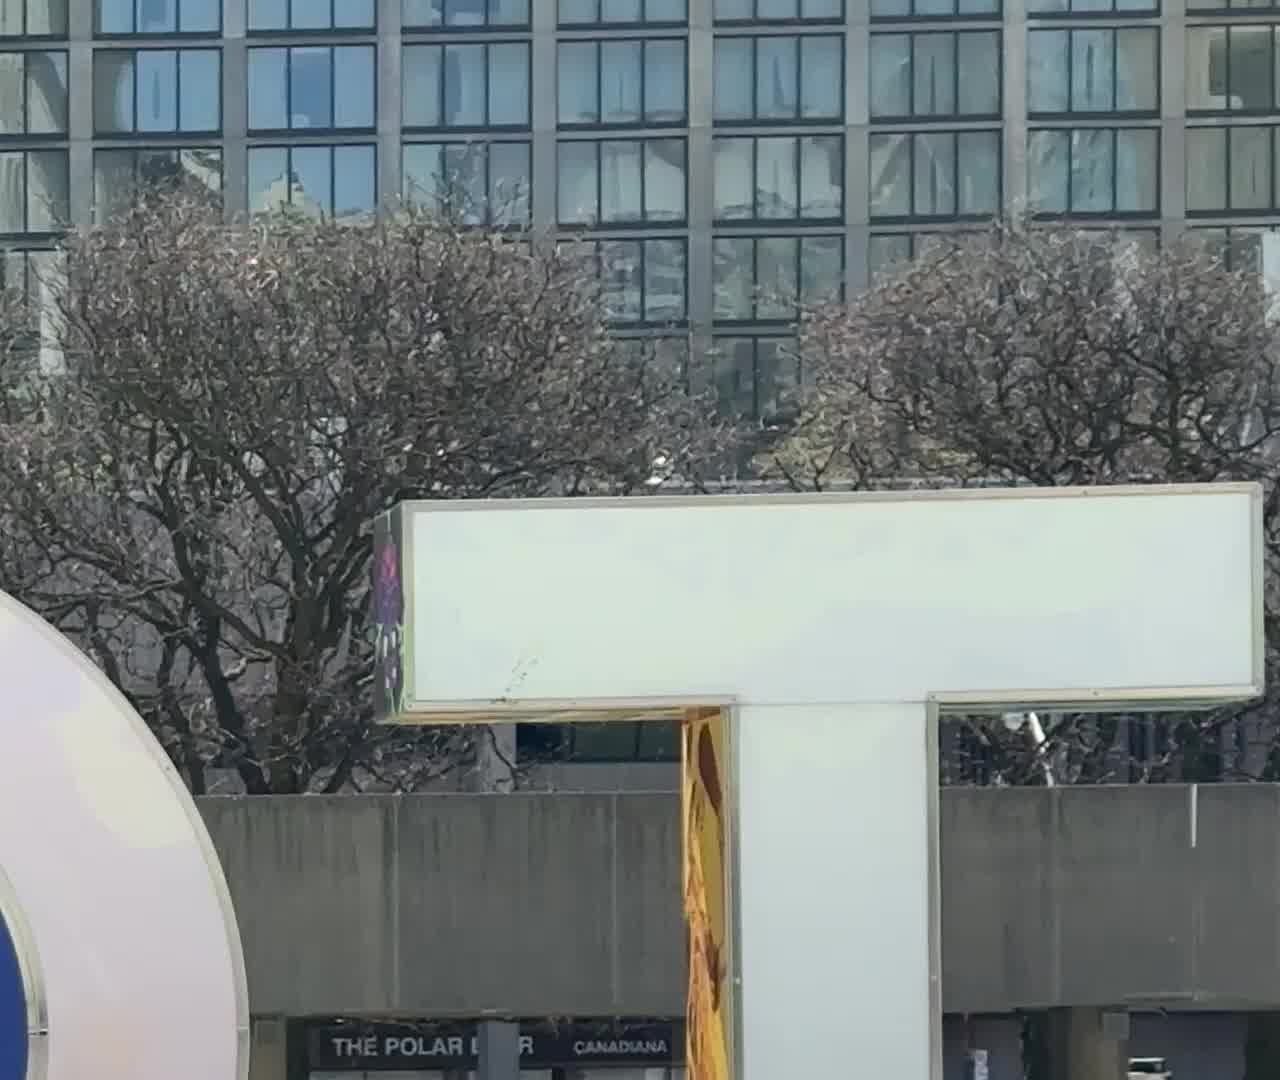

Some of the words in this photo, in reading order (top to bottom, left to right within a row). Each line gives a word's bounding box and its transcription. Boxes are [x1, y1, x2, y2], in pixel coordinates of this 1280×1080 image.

[332, 1036, 378, 1057] THE
[384, 1036, 464, 1057] POLAR
[573, 1039, 668, 1055] CANADIANA
